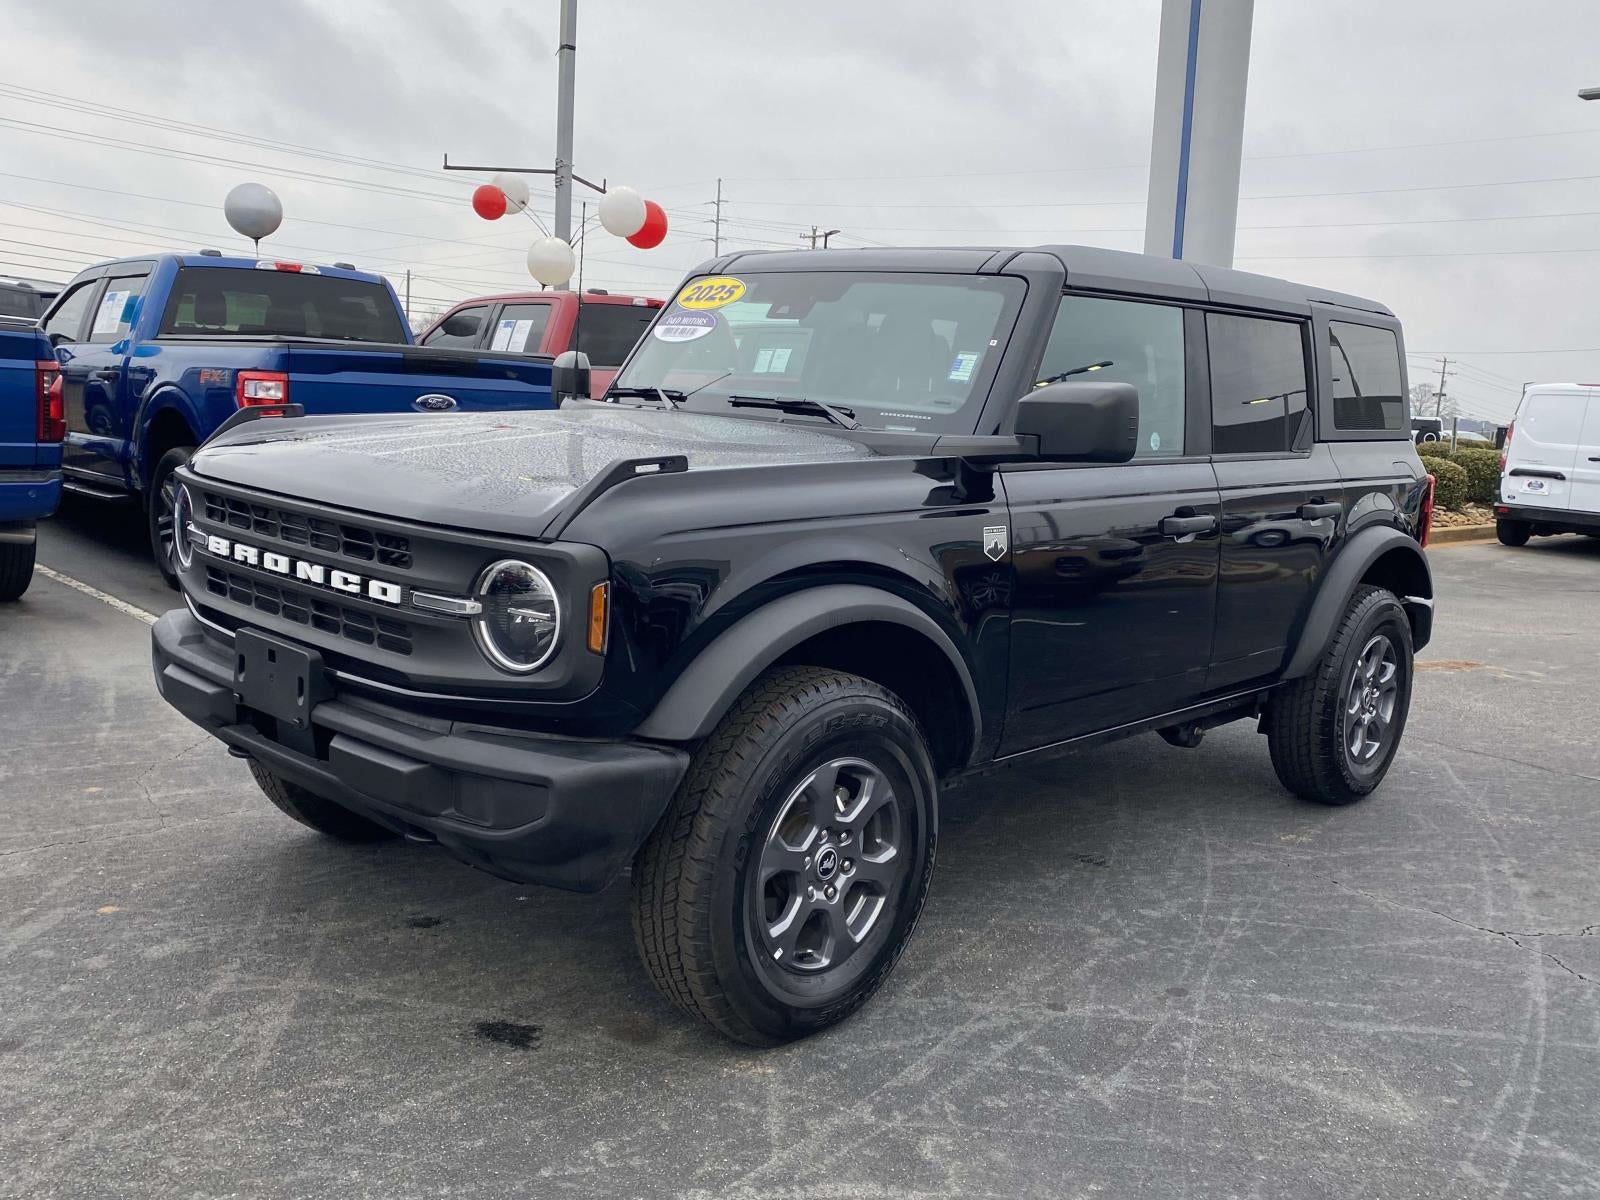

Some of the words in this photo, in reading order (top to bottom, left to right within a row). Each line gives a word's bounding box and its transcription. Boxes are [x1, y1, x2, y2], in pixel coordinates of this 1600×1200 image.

[683, 284, 741, 302] 2025
[199, 368, 230, 384] FX4
[426, 397, 448, 409] Ford
[207, 535, 401, 604] BRONCO
